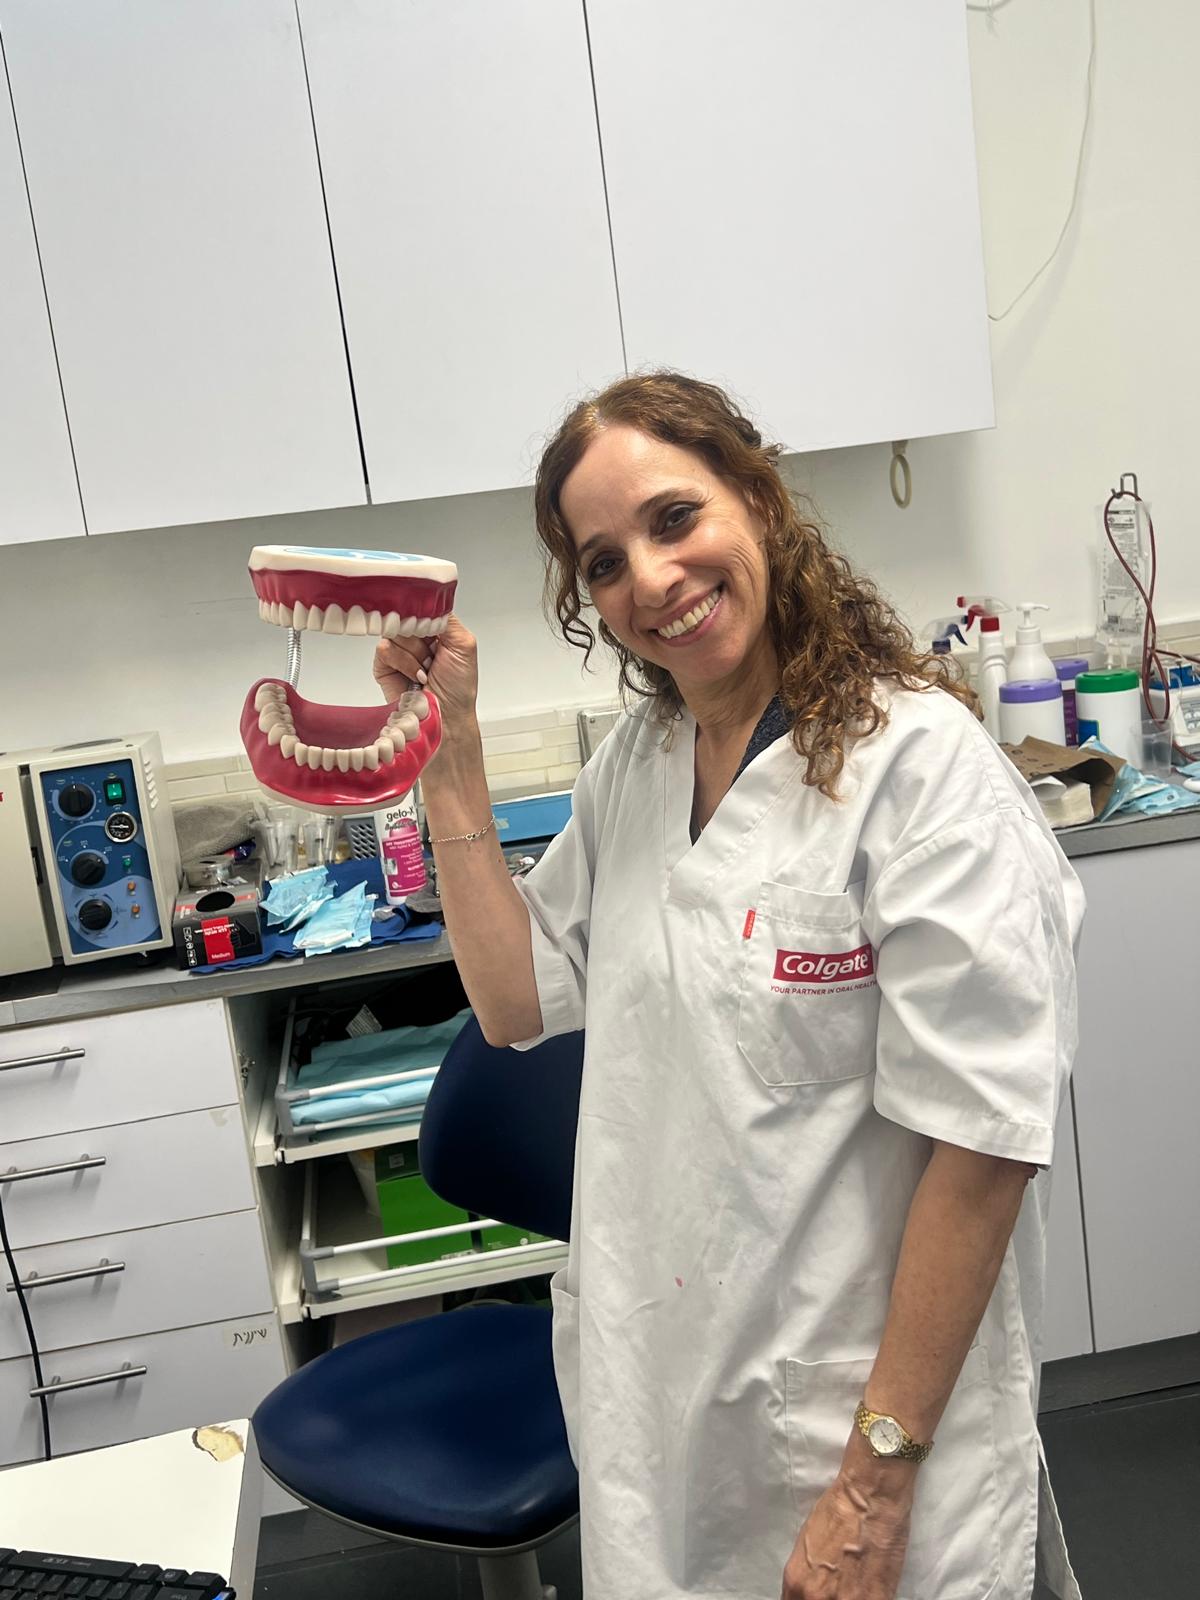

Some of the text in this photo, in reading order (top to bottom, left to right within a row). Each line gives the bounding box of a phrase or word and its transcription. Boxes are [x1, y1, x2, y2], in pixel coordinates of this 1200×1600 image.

[782, 953, 868, 980] Colgate
[770, 985, 790, 995] YOUR
[791, 987, 826, 995] PARTNER
[827, 987, 834, 995] IN
[836, 985, 853, 994] ORAL
